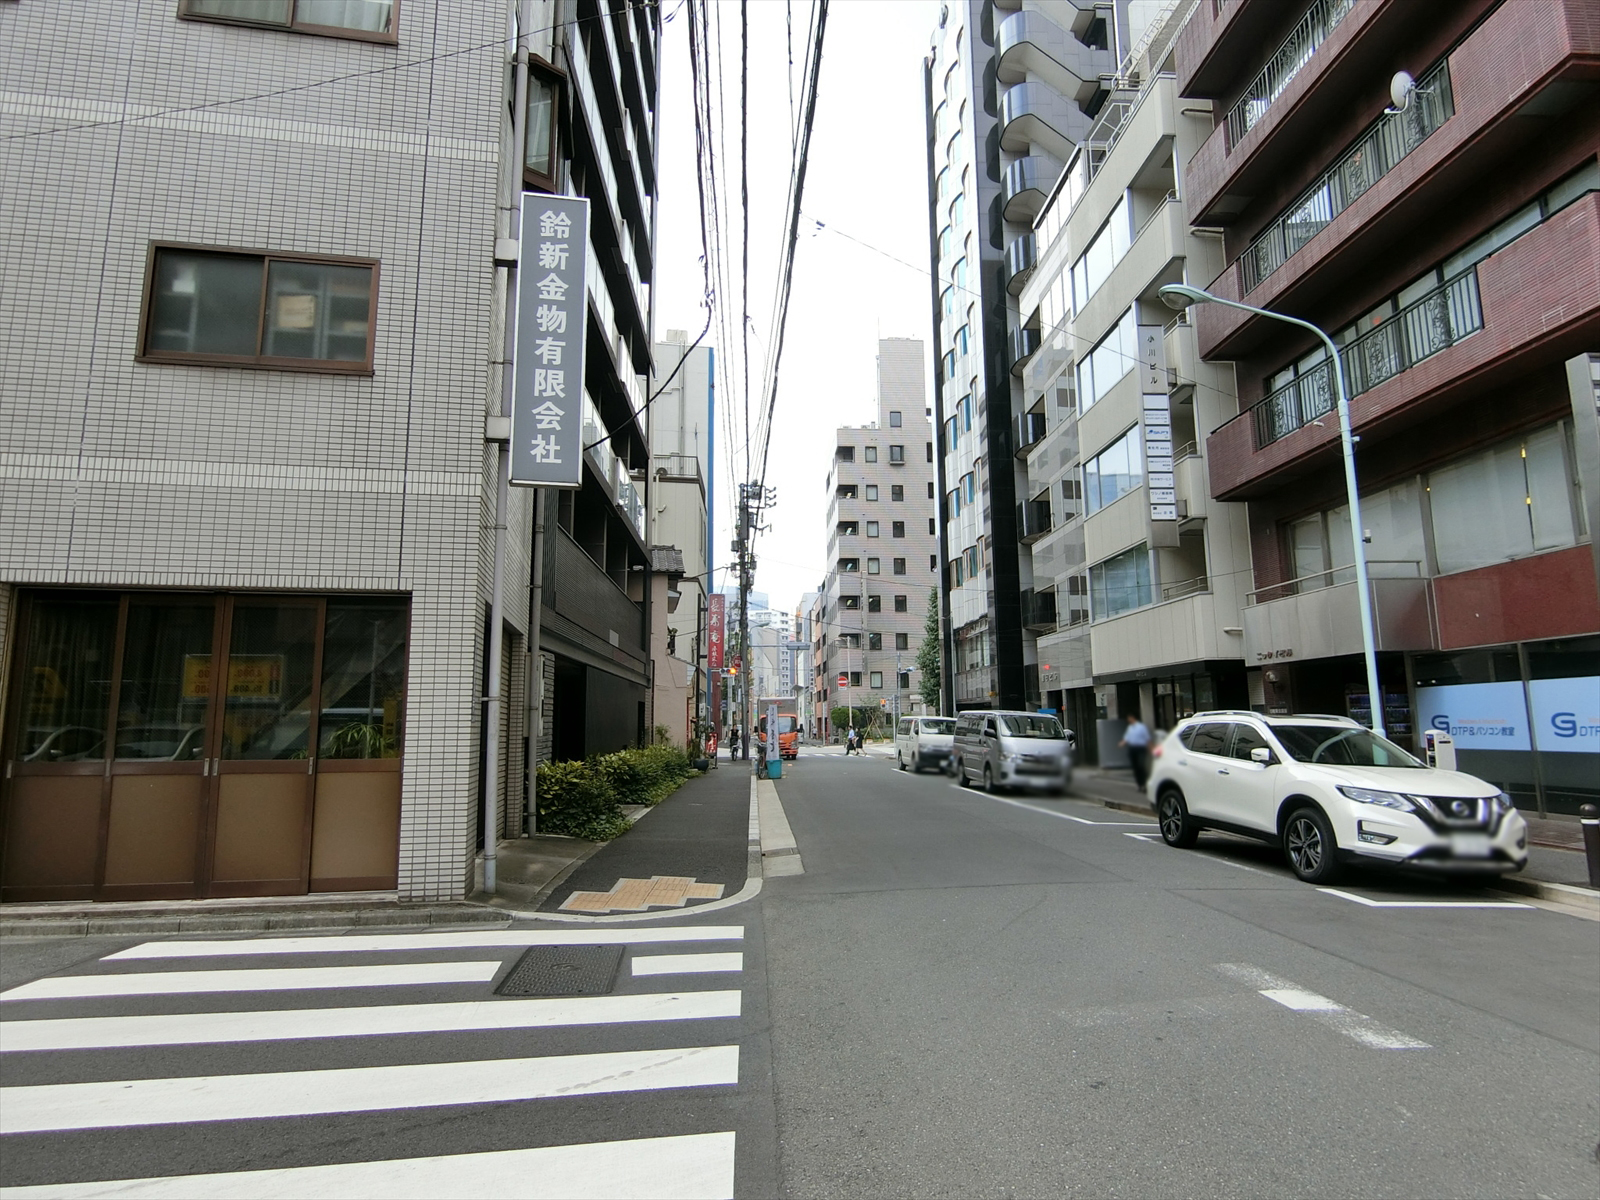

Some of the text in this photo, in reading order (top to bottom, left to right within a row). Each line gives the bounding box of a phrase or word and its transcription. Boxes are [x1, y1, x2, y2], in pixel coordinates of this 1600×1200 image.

[529, 210, 572, 465] 鈴新金物有限会社
[1147, 335, 1158, 384] 小川ビル
[1451, 726, 1515, 736] DTP&パソコン教室
